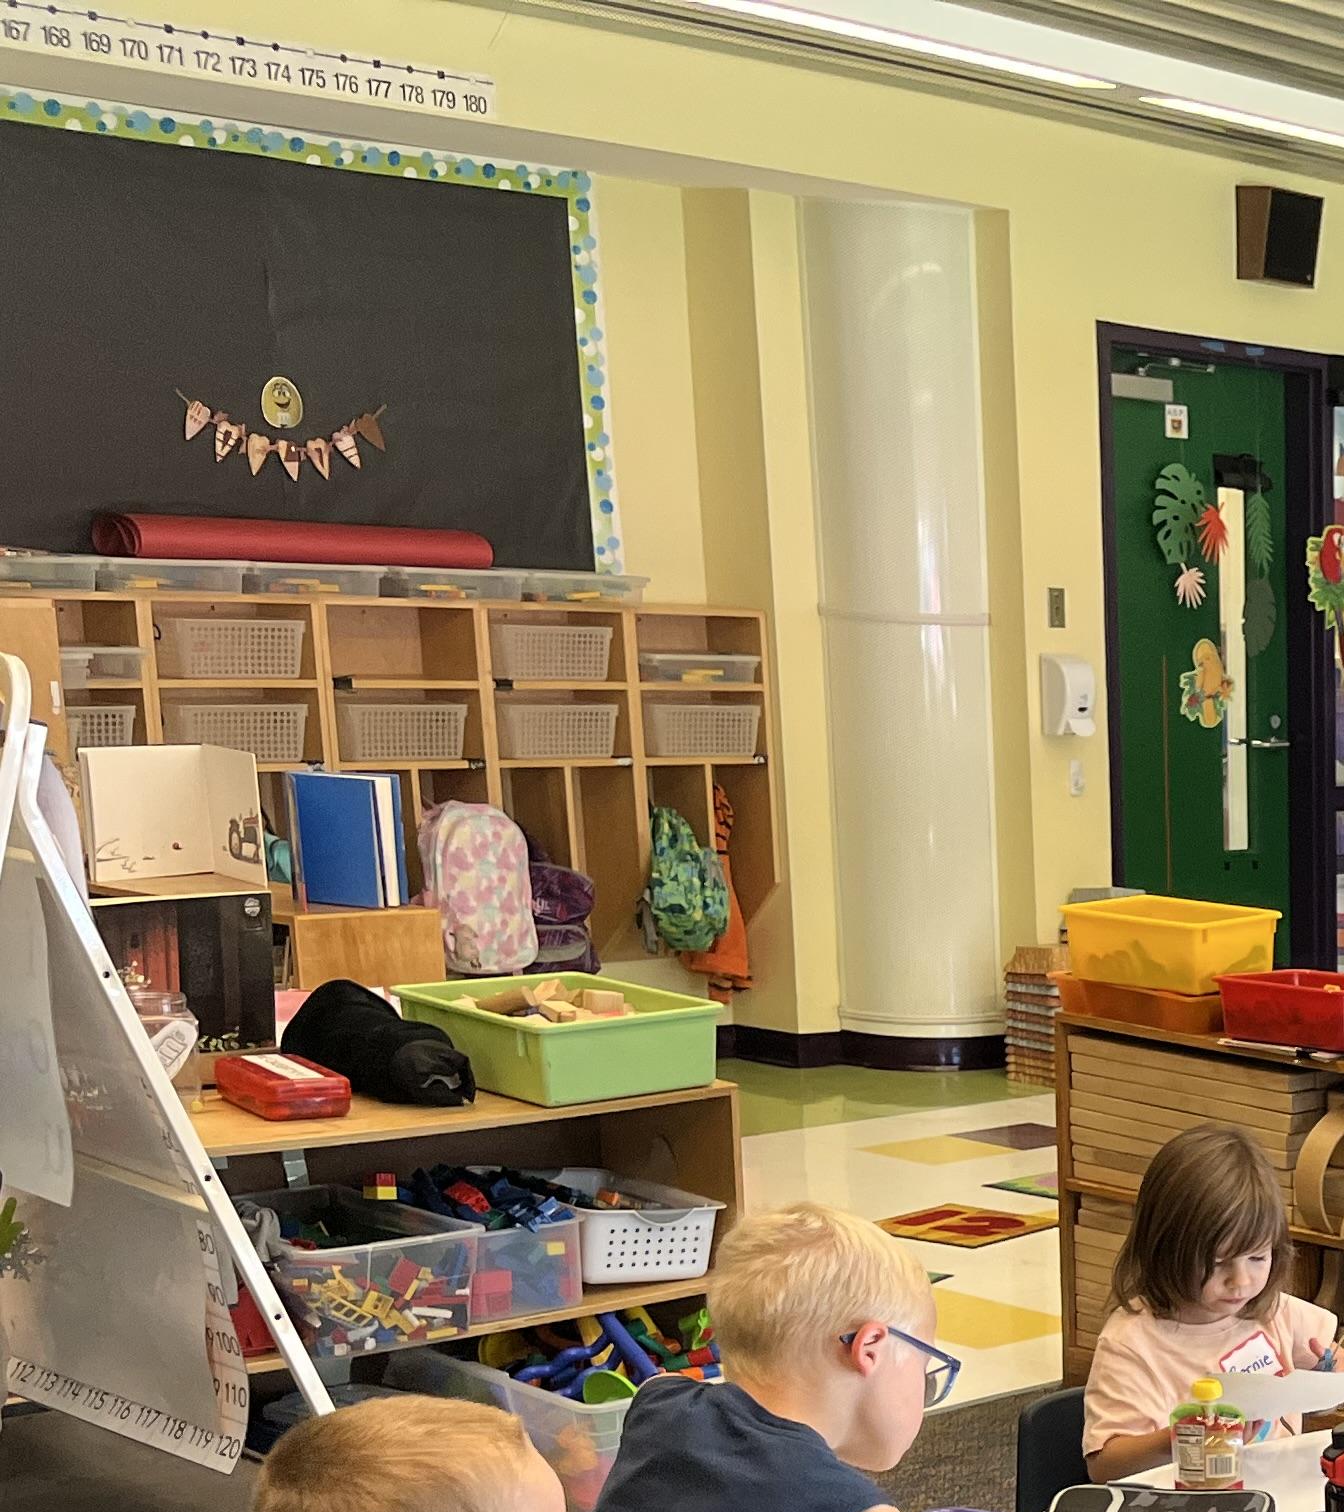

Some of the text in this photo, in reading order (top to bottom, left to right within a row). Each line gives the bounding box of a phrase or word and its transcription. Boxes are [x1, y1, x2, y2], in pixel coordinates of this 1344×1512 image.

[1, 18, 487, 115] 167 168 169 170 171 172 173 174 175 176 177 178 179 180
[206, 1281, 225, 1308] 90
[215, 1330, 241, 1357] 100
[1229, 1354, 1274, 1373] rnie
[224, 1382, 248, 1408] 110
[10, 1360, 242, 1460] 112 113 114 115 116 117 118 119 120
